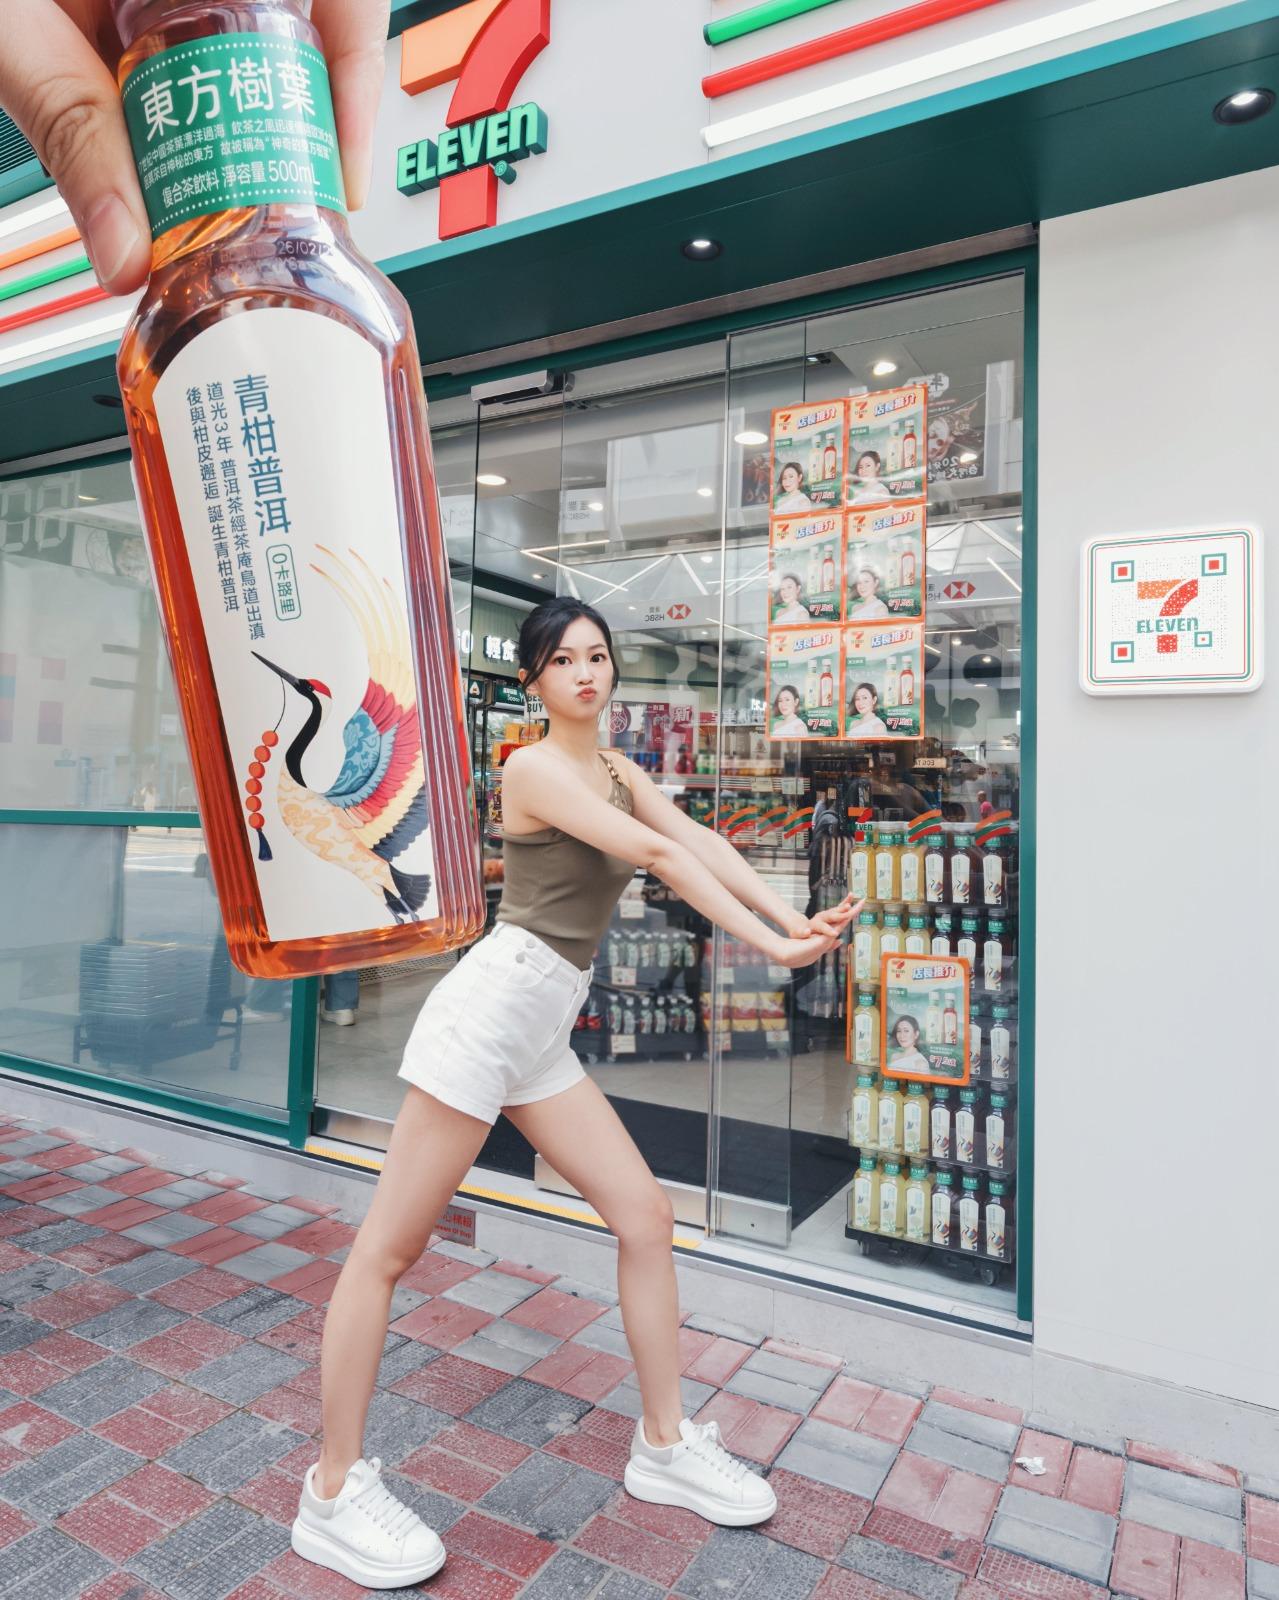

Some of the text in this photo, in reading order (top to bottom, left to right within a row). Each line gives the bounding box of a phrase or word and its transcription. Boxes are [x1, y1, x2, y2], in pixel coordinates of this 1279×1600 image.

[140, 56, 315, 142] 東方樹葉
[221, 160, 266, 188] 淨容量
[268, 160, 321, 186] 500mL
[206, 381, 233, 453] 道光3年
[233, 374, 291, 537] 青柑普洱
[186, 386, 240, 613] 後與柑皮邂逅 誕生青柑普洱
[271, 553, 296, 615] 0卡路里
[526, 702, 543, 713] BUY
[912, 965, 957, 980] 店長推介
